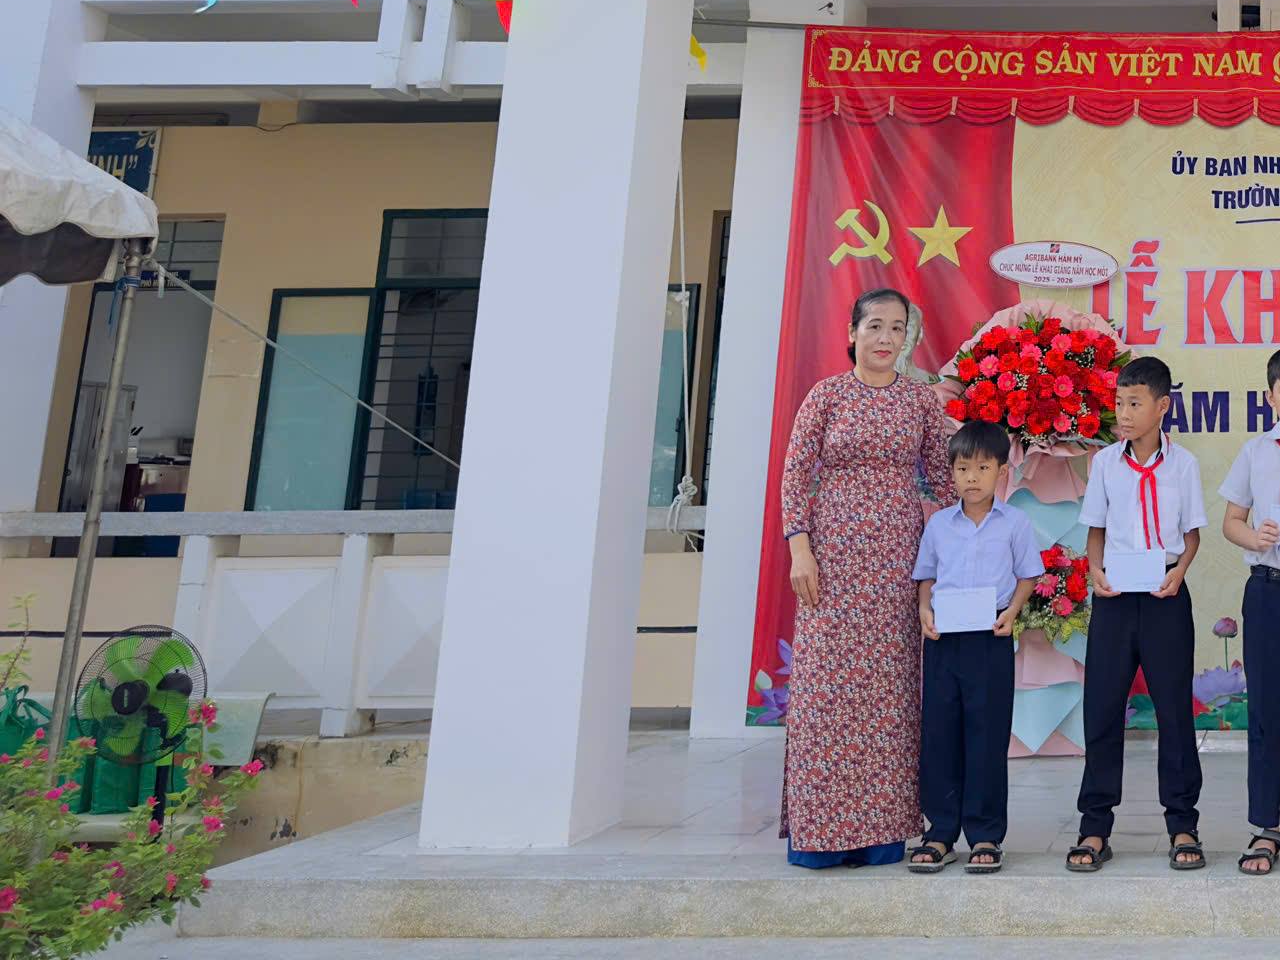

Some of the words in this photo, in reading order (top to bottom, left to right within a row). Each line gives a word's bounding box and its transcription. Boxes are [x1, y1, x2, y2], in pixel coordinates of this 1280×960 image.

[828, 40, 921, 73] ĐẢNG
[932, 44, 1025, 81] CỘNG
[1035, 42, 1096, 74] SẢN
[1106, 47, 1183, 84] VIỆT
[1193, 50, 1262, 77] NAM
[1172, 150, 1199, 175] ỦY
[1205, 155, 1247, 177] BAN
[1024, 253, 1057, 262] AGRIBANK
